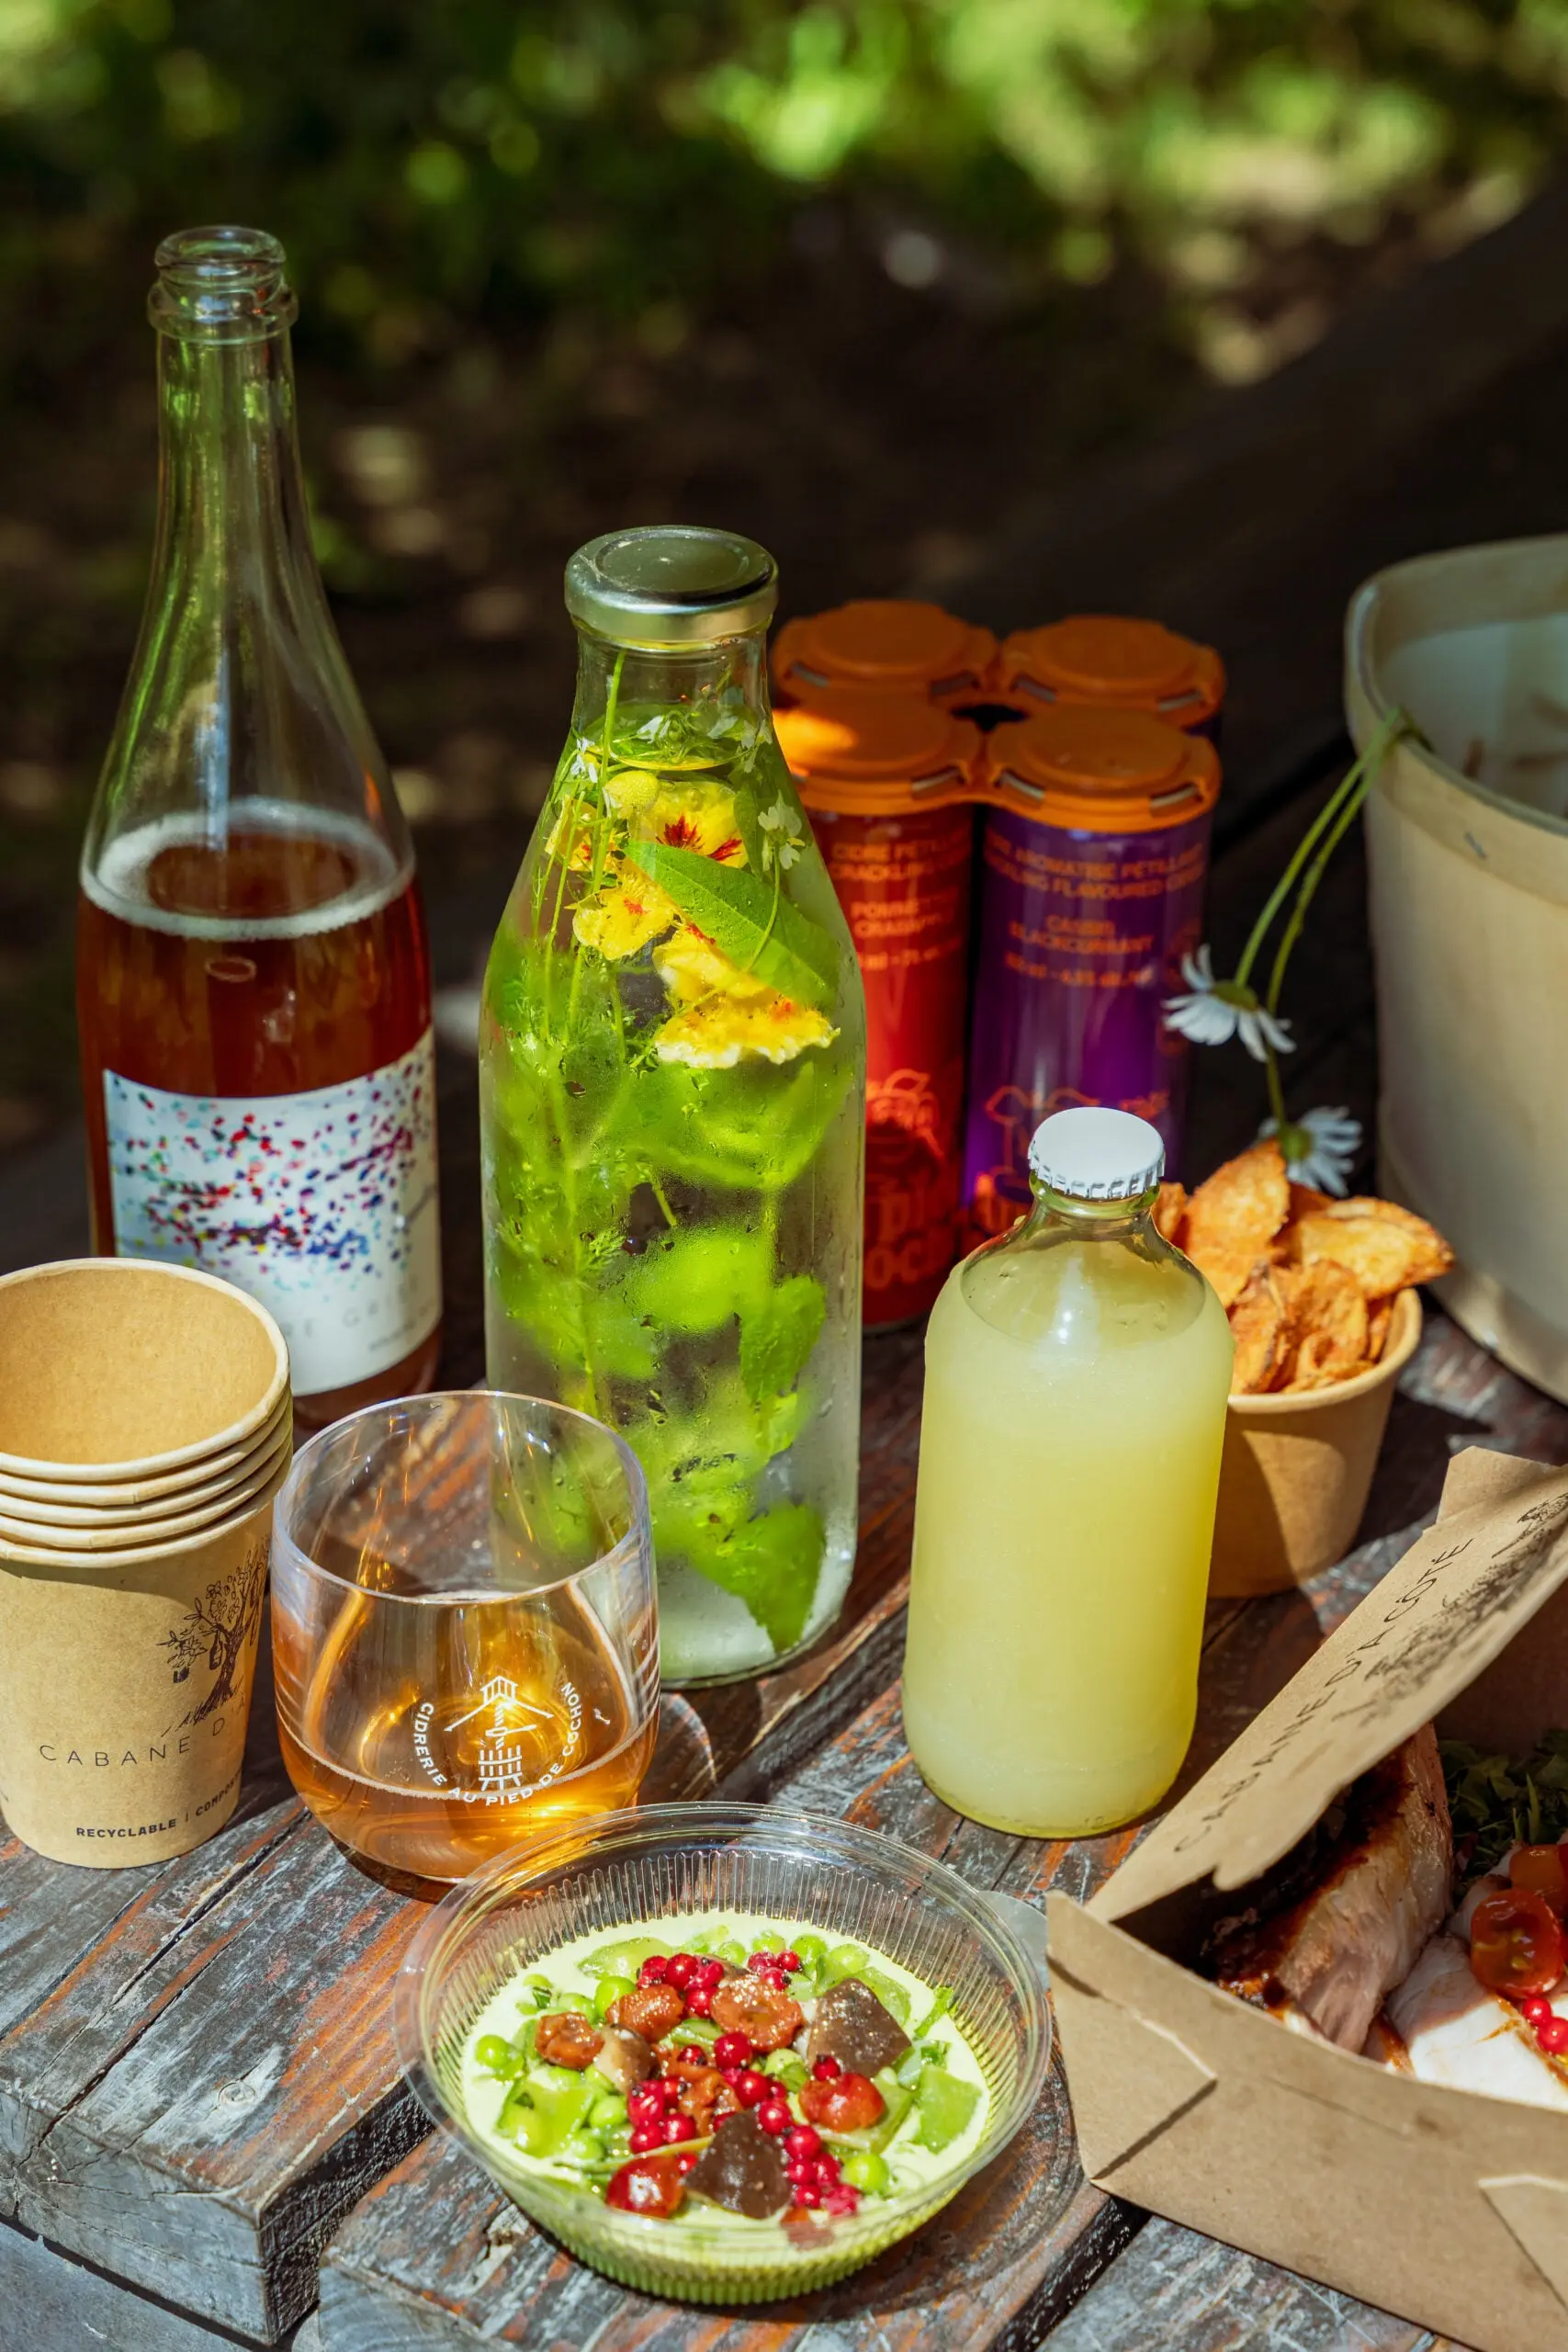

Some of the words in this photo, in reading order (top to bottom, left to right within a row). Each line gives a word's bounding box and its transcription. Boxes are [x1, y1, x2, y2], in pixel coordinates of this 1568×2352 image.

[1173, 1689, 1337, 1852] CABANE
[1382, 1537, 1474, 1623] CÔTÉ
[39, 1736, 191, 1767] CABANE
[413, 1702, 447, 1786] CIDRERIE
[448, 1786, 477, 1804] AU
[485, 1787, 534, 1806] PIED
[538, 1762, 564, 1787] DE
[560, 1681, 581, 1757] COCHON
[76, 1818, 177, 1838] RECYCLABLE
